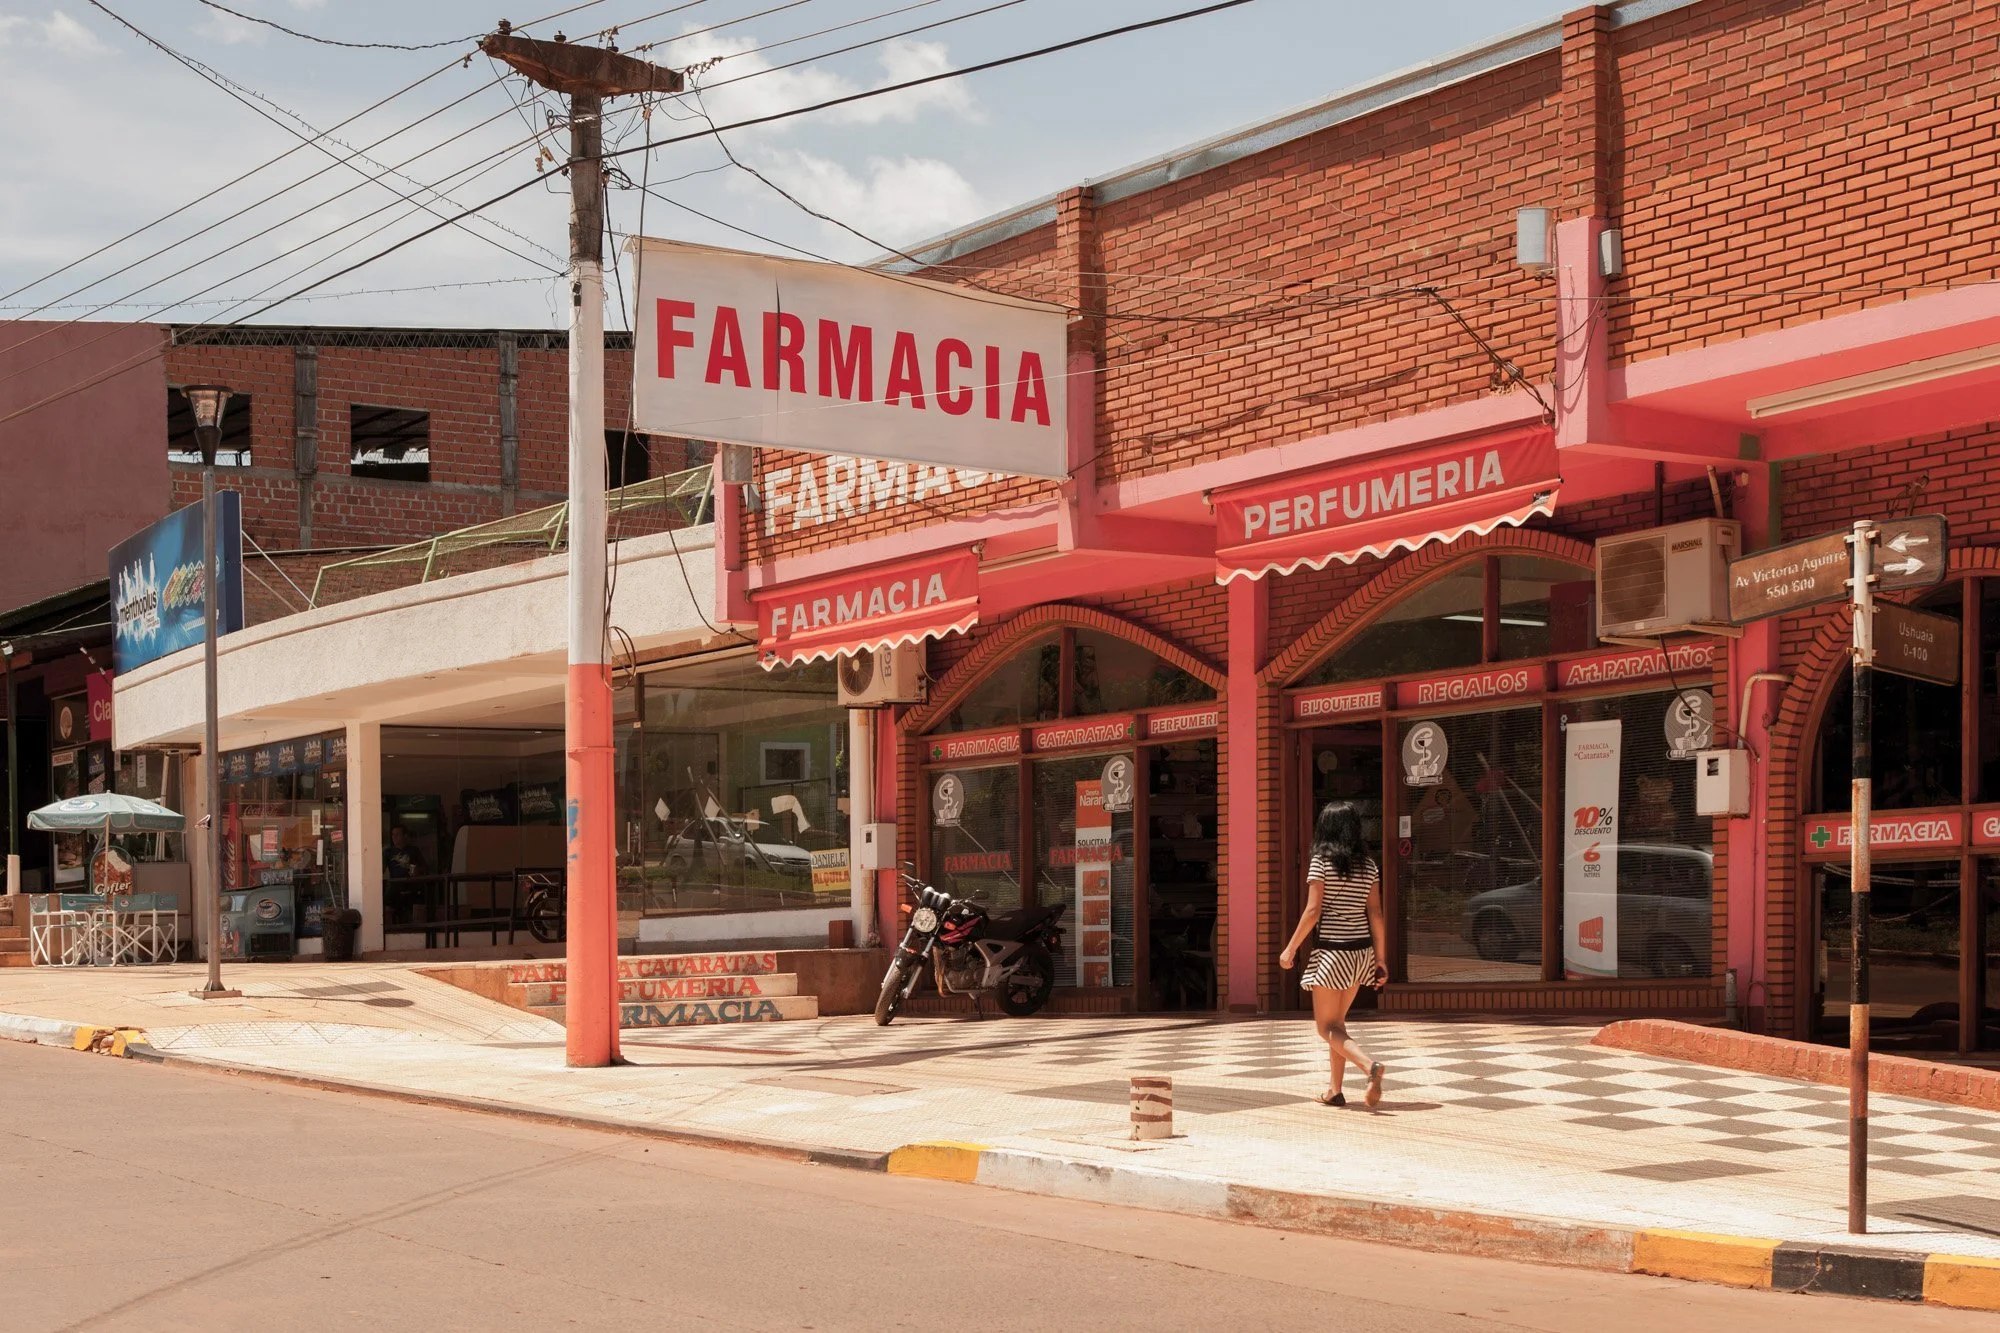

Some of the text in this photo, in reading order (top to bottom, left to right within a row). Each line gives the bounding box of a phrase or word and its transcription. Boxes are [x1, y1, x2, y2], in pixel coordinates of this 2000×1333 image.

[656, 298, 1051, 426] FARMACIA
[764, 454, 1019, 537] FARMA
[1244, 450, 1505, 539] PERFUMERIA
[1735, 550, 1847, 588] Av Victoria Aguirre
[119, 589, 157, 625] menthoplus
[771, 573, 947, 636] FARMACIA
[1899, 622, 1934, 642] Ushuaia
[1903, 644, 1928, 661] 0-100
[1566, 663, 1602, 686] Art.
[1603, 655, 1654, 681] PARA
[1418, 671, 1528, 704] REGALOS
[93, 700, 112, 722] Cla
[1300, 691, 1382, 716] BIJOUTERIE
[1151, 712, 1218, 734] PERFUMERI
[1036, 724, 1123, 749] CATARATAS
[1578, 743, 1609, 751] FARMACIA
[1080, 795, 1104, 807] Naran
[1574, 806, 1613, 829] 10%
[1574, 827, 1612, 836] DESCUENTO
[1837, 820, 1953, 846] FRMACIA
[944, 852, 1013, 873] FARMACIA
[1050, 844, 1124, 866] FARMACIA
[1583, 841, 1601, 863] 6
[1583, 864, 1601, 873] CERO
[636, 952, 777, 978] CATARATAS
[620, 1000, 784, 1027] RMACIA
